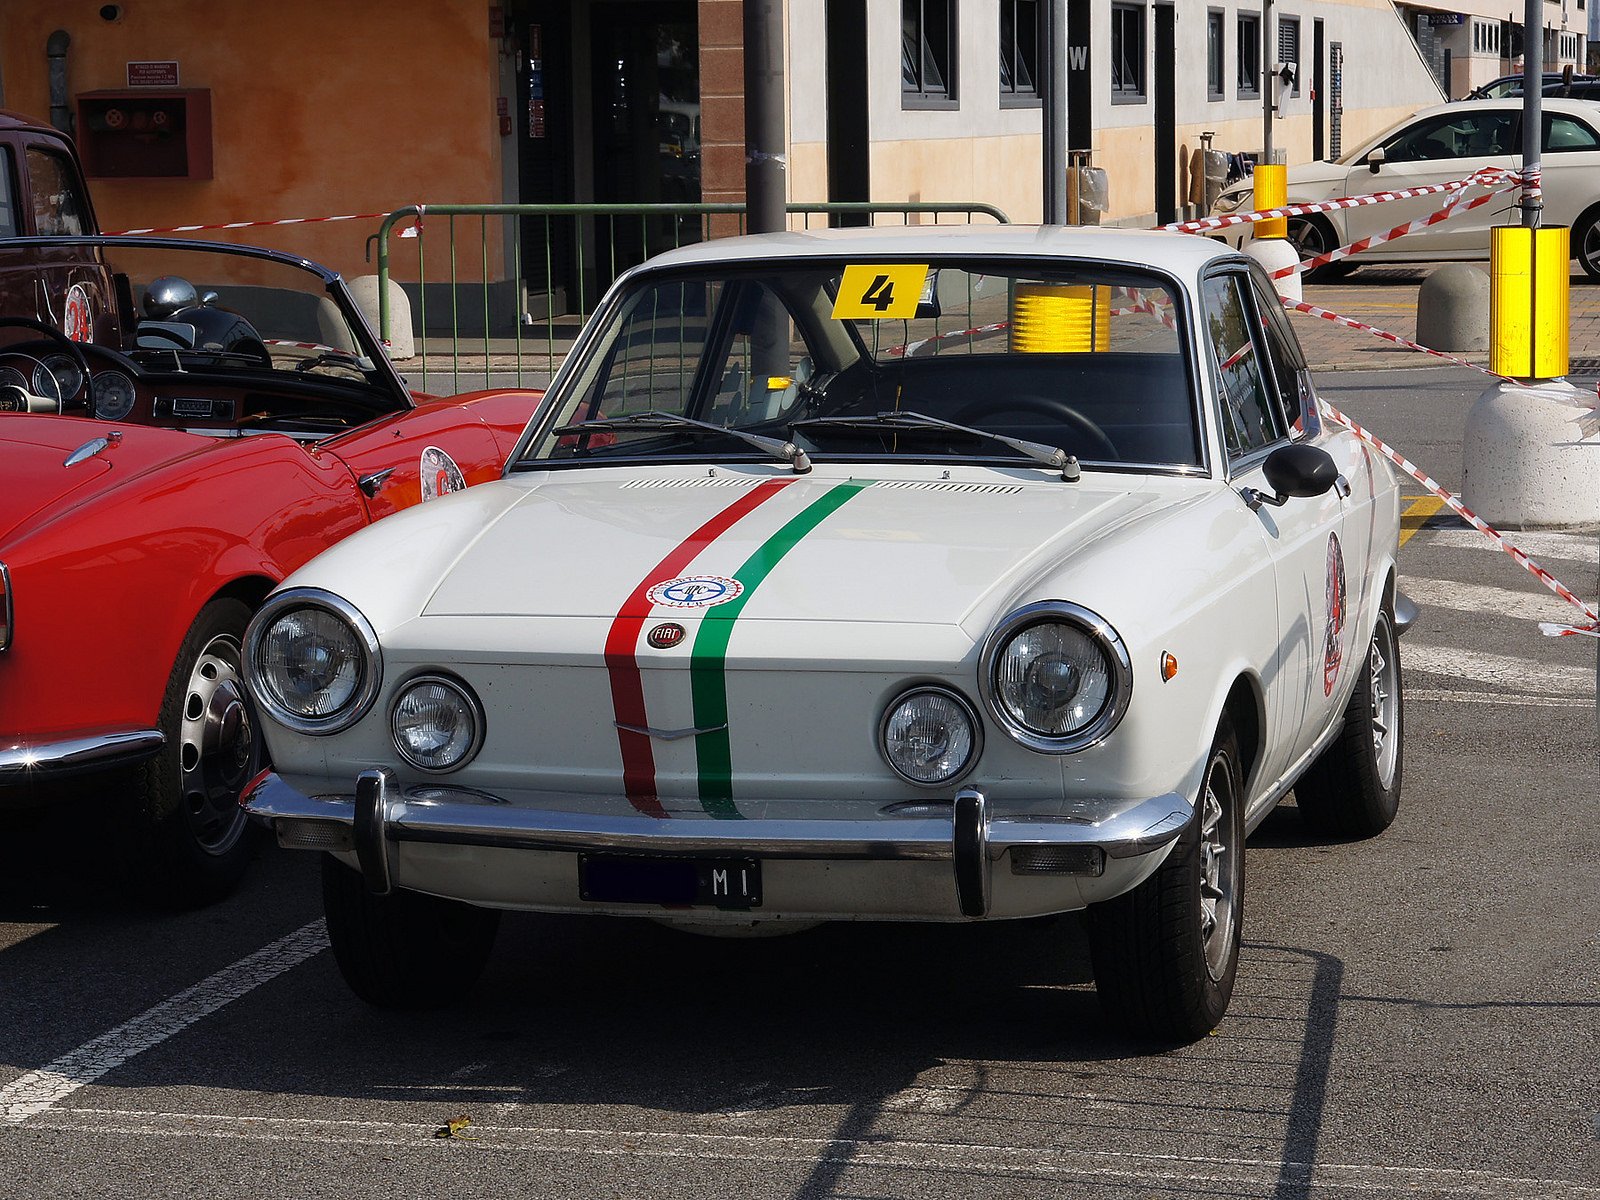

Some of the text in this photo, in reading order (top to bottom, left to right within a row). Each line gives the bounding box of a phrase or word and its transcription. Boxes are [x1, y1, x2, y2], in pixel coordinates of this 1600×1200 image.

[1069, 46, 1087, 70] W
[860, 275, 894, 311] 4
[655, 628, 678, 639] FIAT
